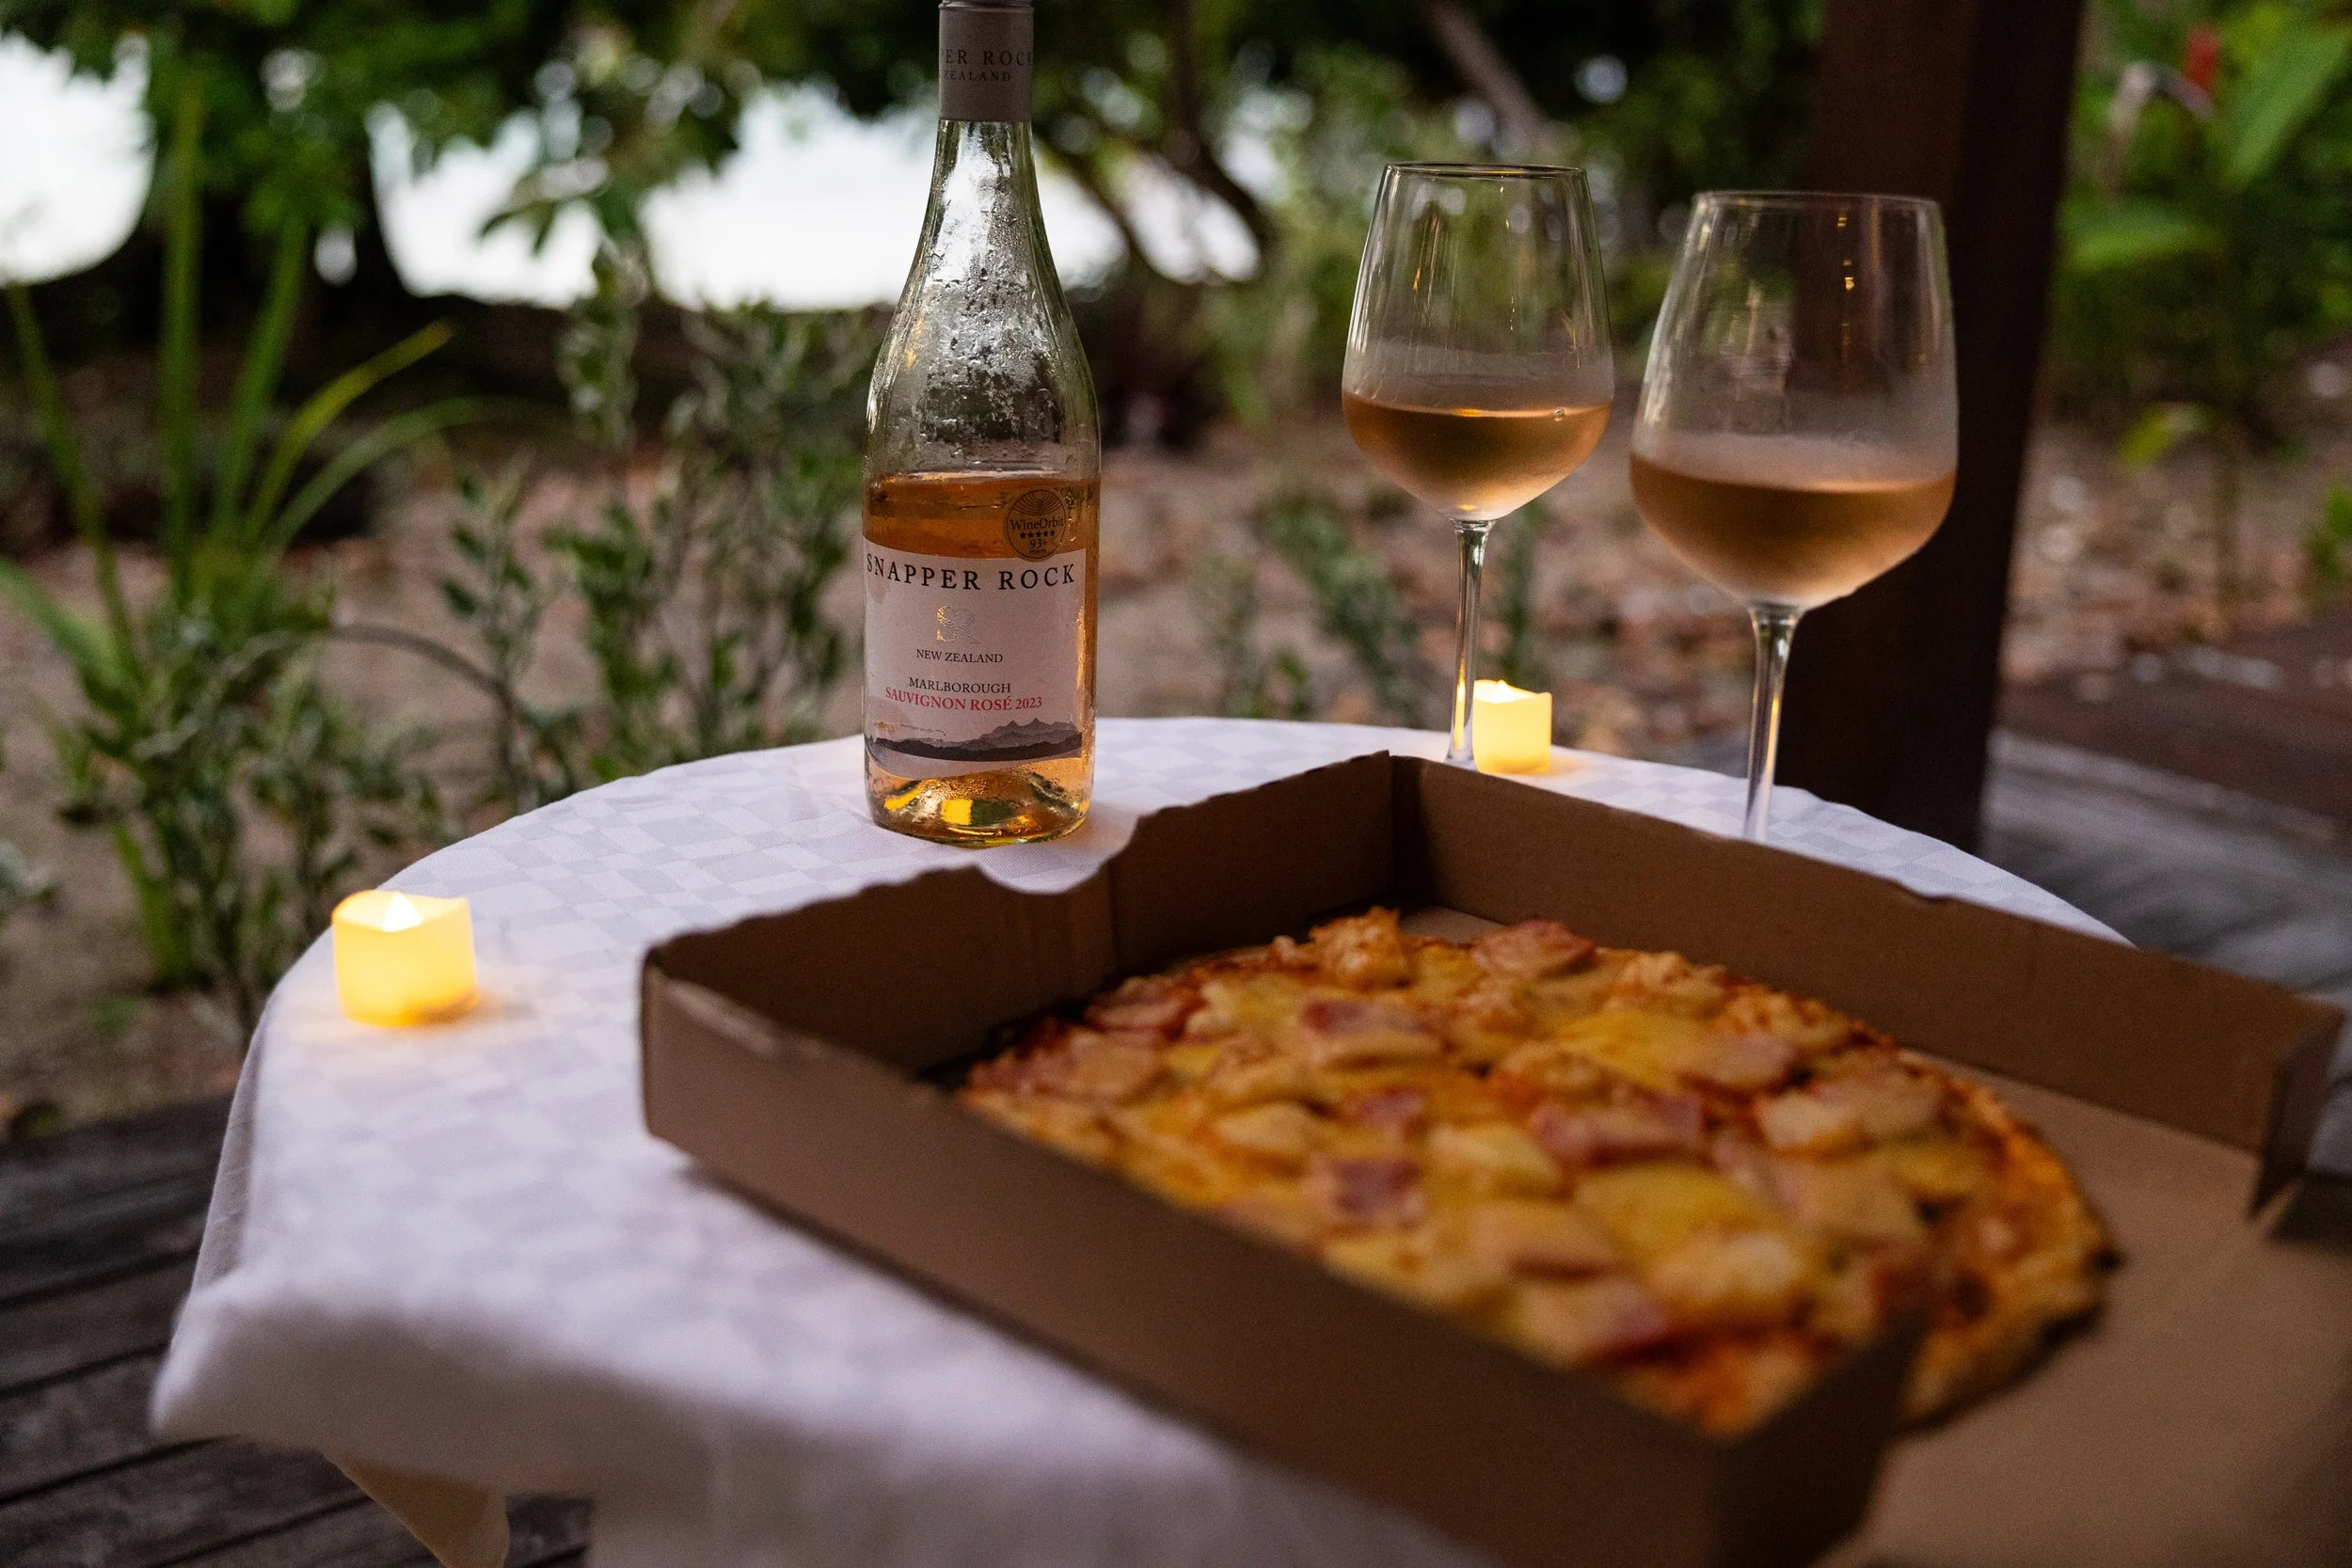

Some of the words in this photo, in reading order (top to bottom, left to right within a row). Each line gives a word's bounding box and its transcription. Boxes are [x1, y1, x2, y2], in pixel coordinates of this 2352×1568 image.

[944, 70, 1010, 83] ZEALAND
[1009, 516, 1064, 531] WineOrbit
[866, 552, 981, 591] SNAPPER
[998, 563, 1074, 591] ROCK
[916, 648, 943, 661] NEW
[945, 652, 1004, 663] ZEALAND
[909, 676, 1011, 694] MARLBOROUGH
[885, 686, 966, 711] SAUVIGNON
[970, 696, 1012, 711] ROSÉ
[1015, 696, 1042, 710] 2023
